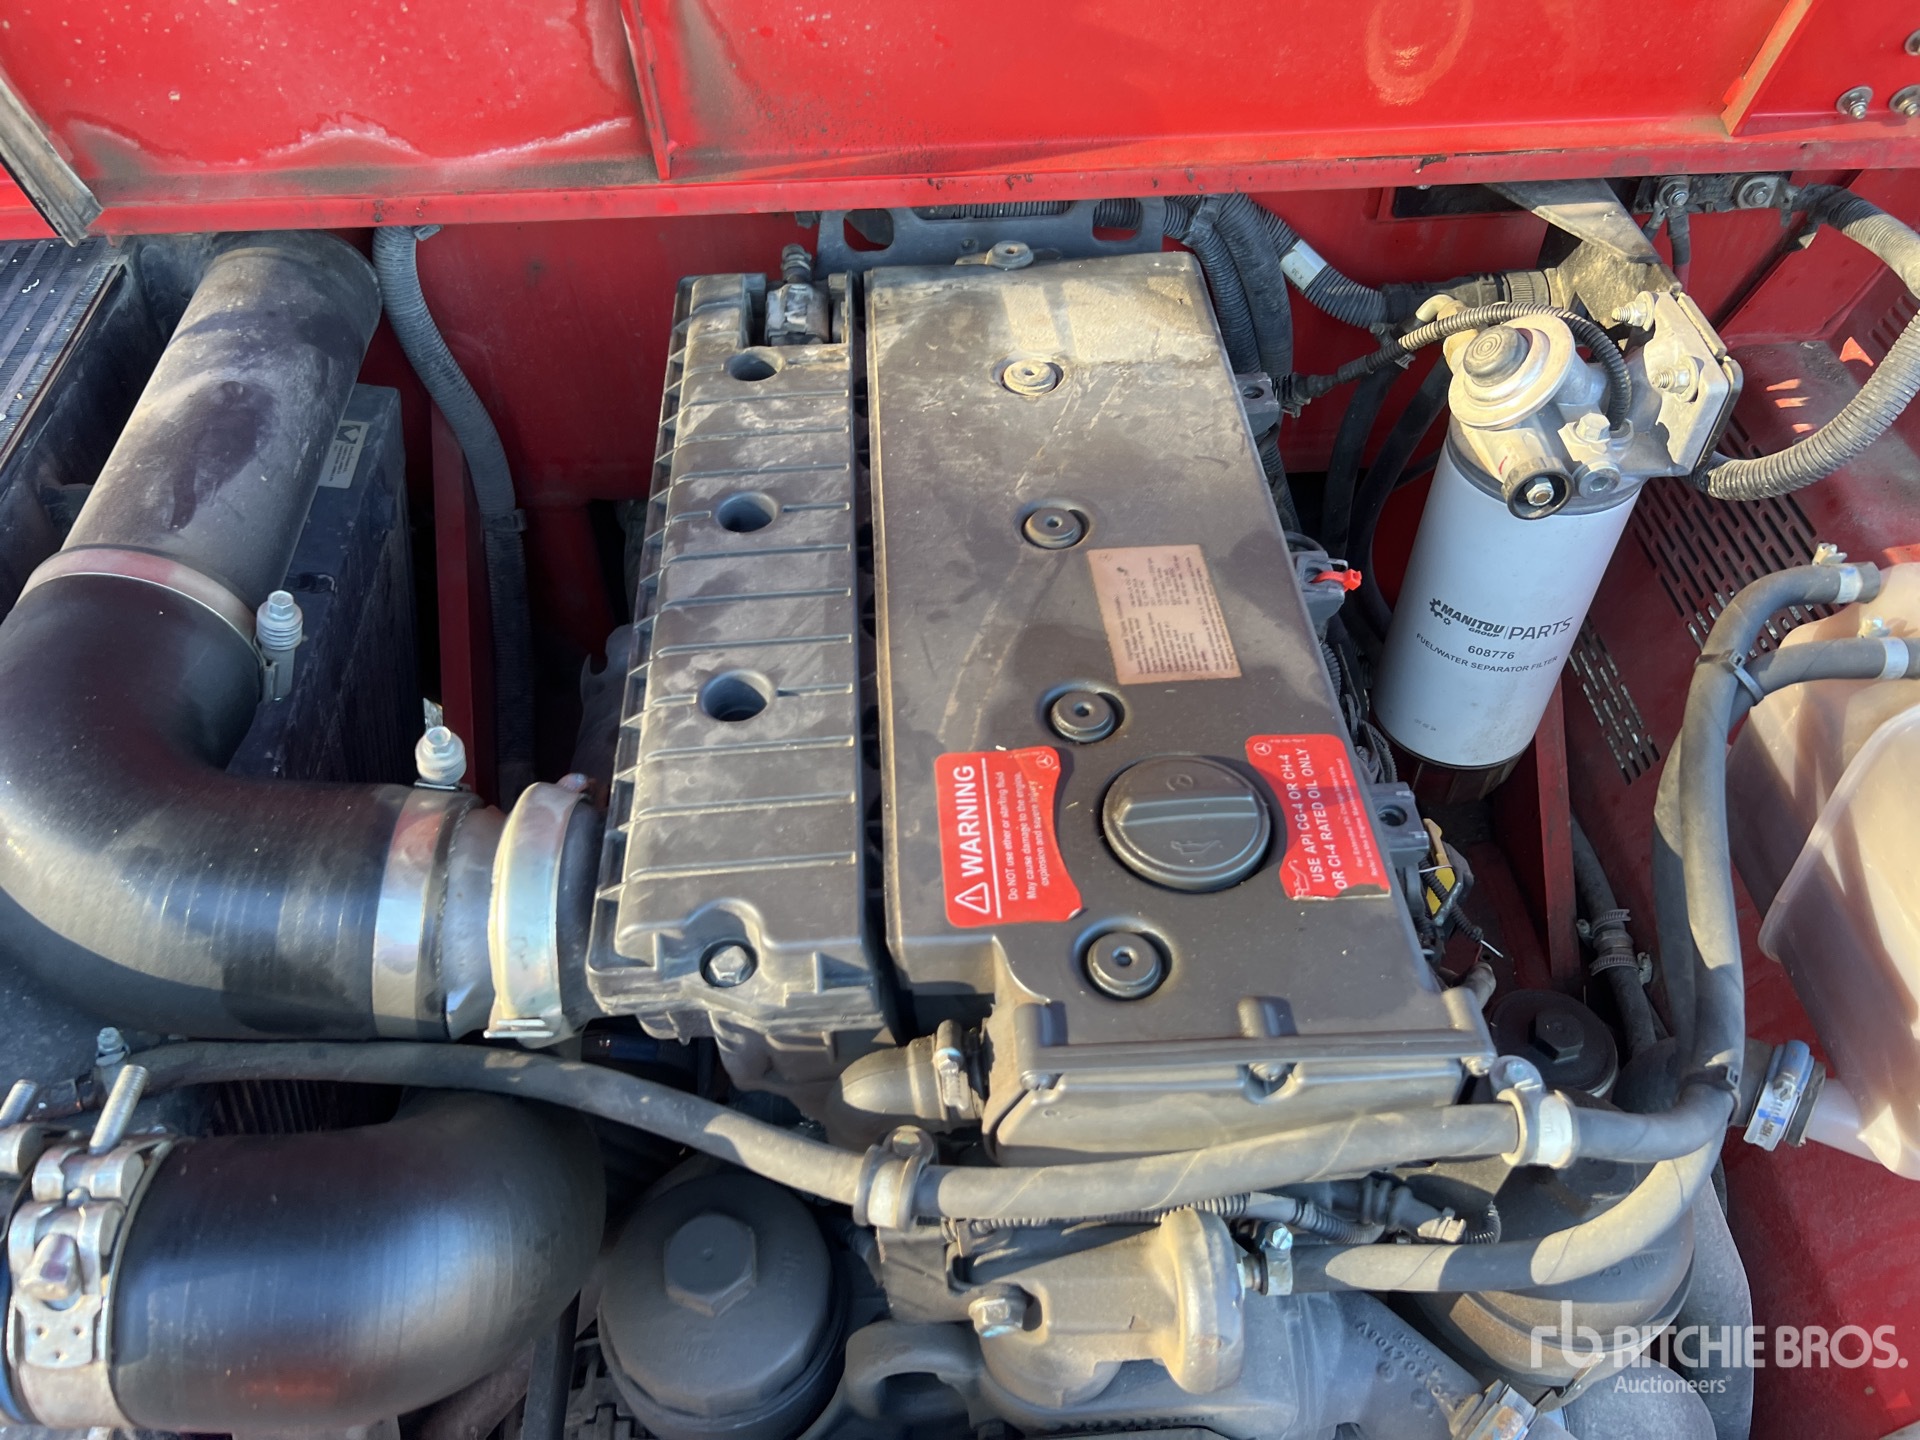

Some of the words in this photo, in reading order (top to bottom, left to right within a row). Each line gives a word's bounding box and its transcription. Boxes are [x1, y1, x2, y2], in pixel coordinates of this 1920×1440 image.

[1441, 604, 1506, 633] MANITOU
[1508, 616, 1573, 640] PARTS
[1469, 627, 1499, 638] GROUP
[1416, 633, 1469, 666] FUEL/WATER
[1470, 662, 1529, 672] SEPARATOR
[1531, 656, 1558, 670] FILTER
[1468, 645, 1515, 659] 608776
[1279, 754, 1296, 779] CH-4
[1296, 748, 1314, 777] ONLY
[995, 771, 1005, 788] fluid
[1307, 780, 1320, 798] OIL
[1028, 781, 1042, 802] injury
[1286, 783, 1300, 799] OR
[997, 789, 1010, 818] starting
[1016, 800, 1026, 811] the
[1337, 793, 1347, 815] Change
[953, 765, 984, 877] WARNING
[1002, 820, 1009, 828] or
[1018, 813, 1027, 821] to
[1031, 805, 1041, 828] severe
[1293, 803, 1310, 830] CG-4
[1312, 802, 1333, 840] RATED
[1001, 830, 1013, 849] ether
[1019, 823, 1032, 853] damage
[1032, 831, 1044, 845] and
[1300, 834, 1317, 854] API
[1346, 826, 1360, 855] Extended
[1004, 852, 1014, 866] use
[1325, 844, 1341, 867] CI-4
[1005, 868, 1017, 886] NOT
[1023, 856, 1034, 879] cause
[1036, 848, 1050, 886] explosion
[1308, 858, 1325, 882] USE
[1332, 871, 1347, 889] OR
[1007, 888, 1019, 900] Do
[1026, 883, 1038, 899] May
